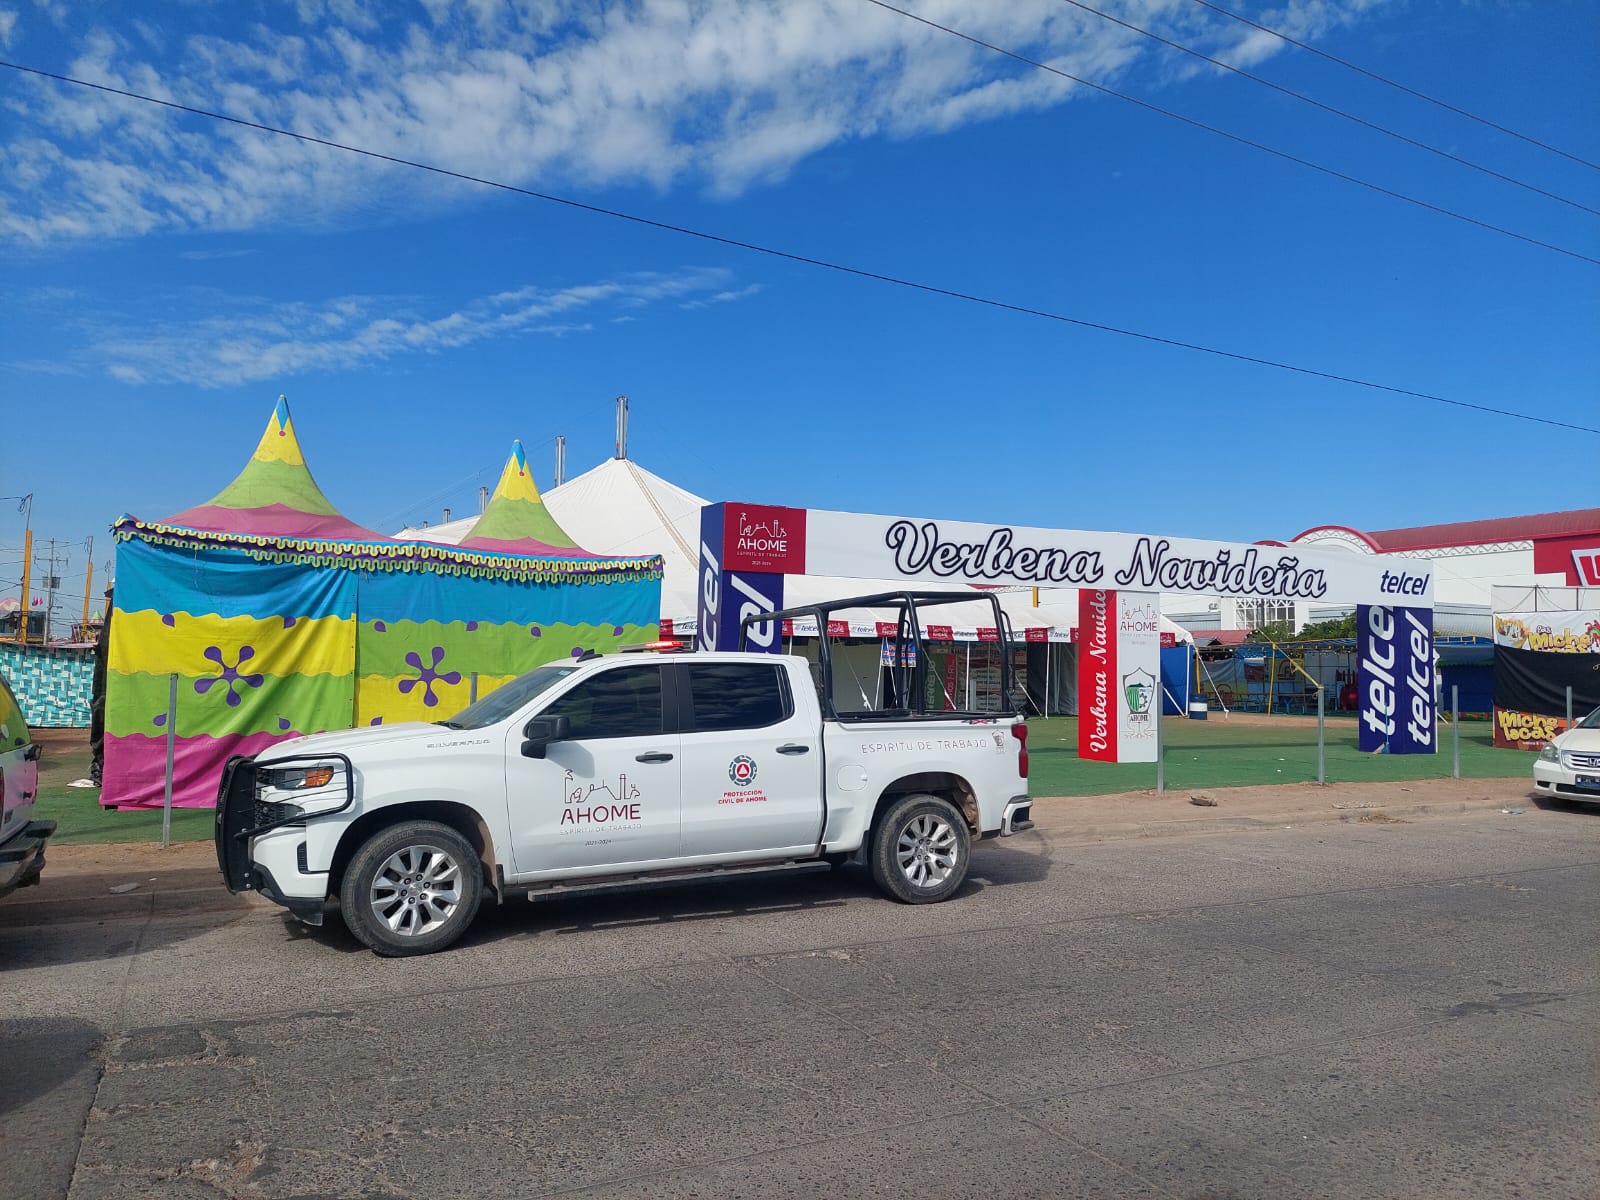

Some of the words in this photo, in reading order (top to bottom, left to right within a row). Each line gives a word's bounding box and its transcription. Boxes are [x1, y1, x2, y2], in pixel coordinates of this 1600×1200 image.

[737, 537, 787, 552] AHOME
[885, 520, 1104, 584] Verbena
[1114, 537, 1327, 598] Navideña
[1380, 570, 1430, 596] telcel
[1120, 621, 1158, 632] AHOME
[1362, 605, 1396, 736] telce
[1405, 610, 1431, 746] telcel
[1089, 671, 1107, 753] Verbena
[918, 741, 932, 750] DE
[938, 739, 987, 750] TRABAJO
[560, 803, 641, 825] AHOME
